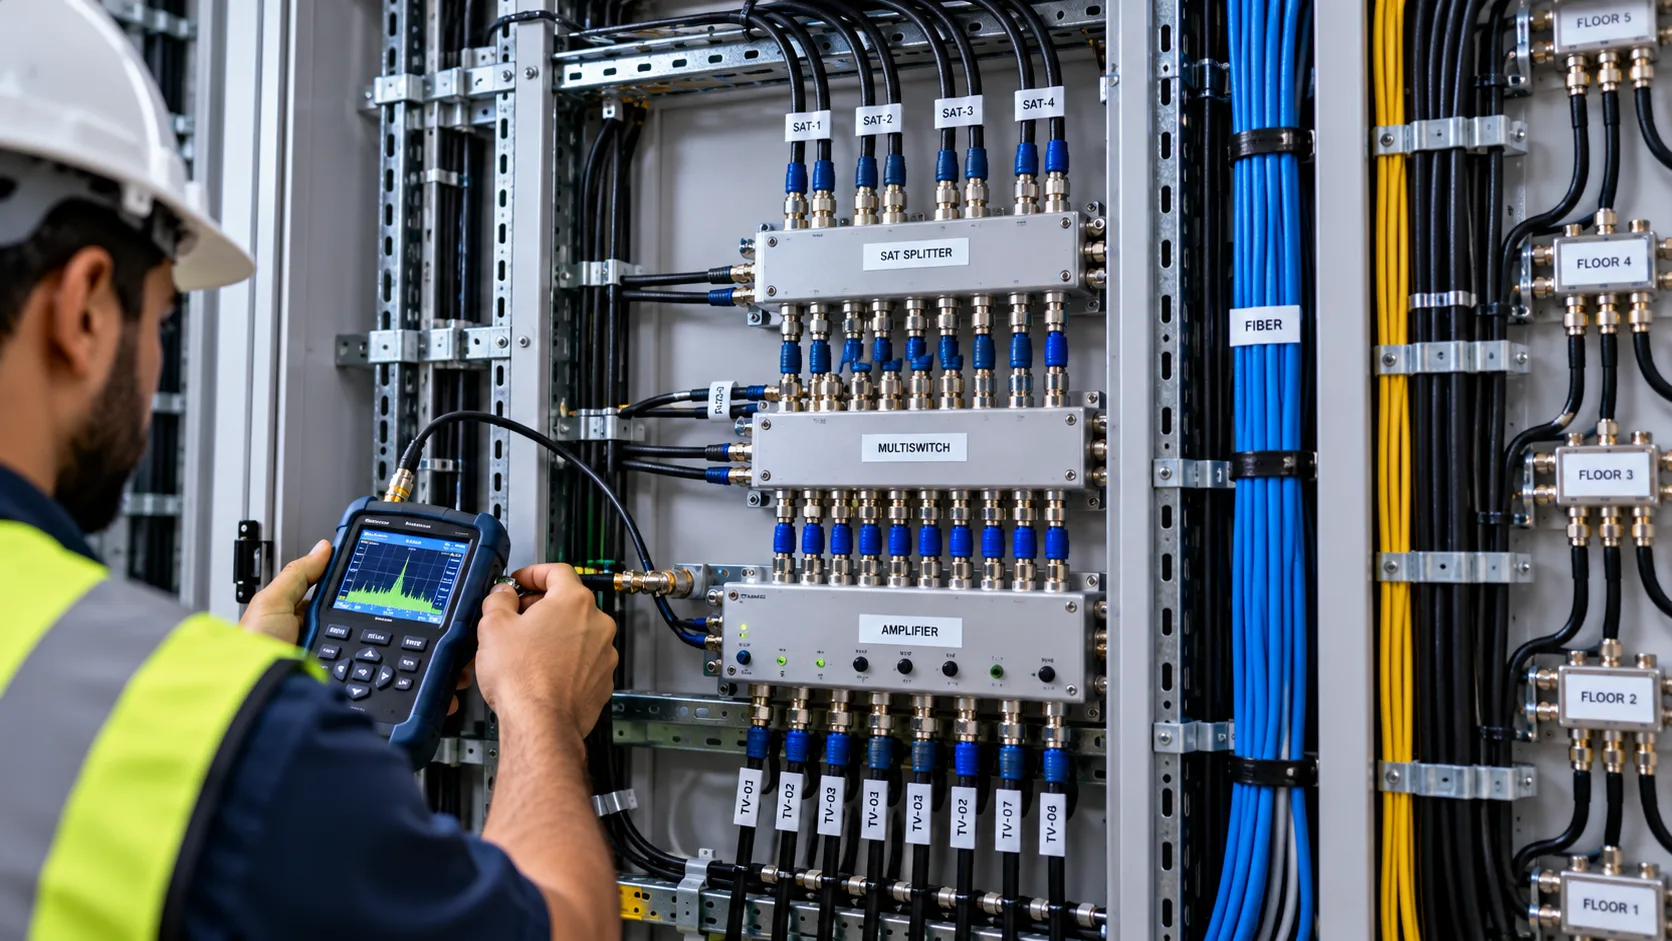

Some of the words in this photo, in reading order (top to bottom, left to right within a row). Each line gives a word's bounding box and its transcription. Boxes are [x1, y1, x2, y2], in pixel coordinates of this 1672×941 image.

[1577, 14, 1619, 28] FLOOR
[1624, 12, 1631, 23] 5
[1023, 97, 1055, 110] SAT-4
[942, 105, 974, 119] SAT-3
[793, 120, 821, 132] SAT-1
[863, 113, 893, 126] SAT-2
[880, 250, 900, 261] SAT
[903, 248, 953, 260] SPLITTER
[1577, 257, 1620, 269] FLOOR
[1623, 256, 1632, 266] 4
[1245, 319, 1283, 332] FIBER
[878, 442, 950, 453] MULTISWITCH
[1579, 470, 1622, 480] FLOOR
[1626, 470, 1634, 480] 3
[881, 624, 939, 637] AMPLIFIER
[1581, 691, 1625, 704] FLOOR
[1629, 694, 1637, 705] 2
[782, 783, 795, 819] TV-02
[824, 787, 836, 824] TV-03
[1002, 801, 1013, 839] TV-07
[1583, 898, 1628, 914] FLOOR
[1633, 905, 1639, 915] 1
